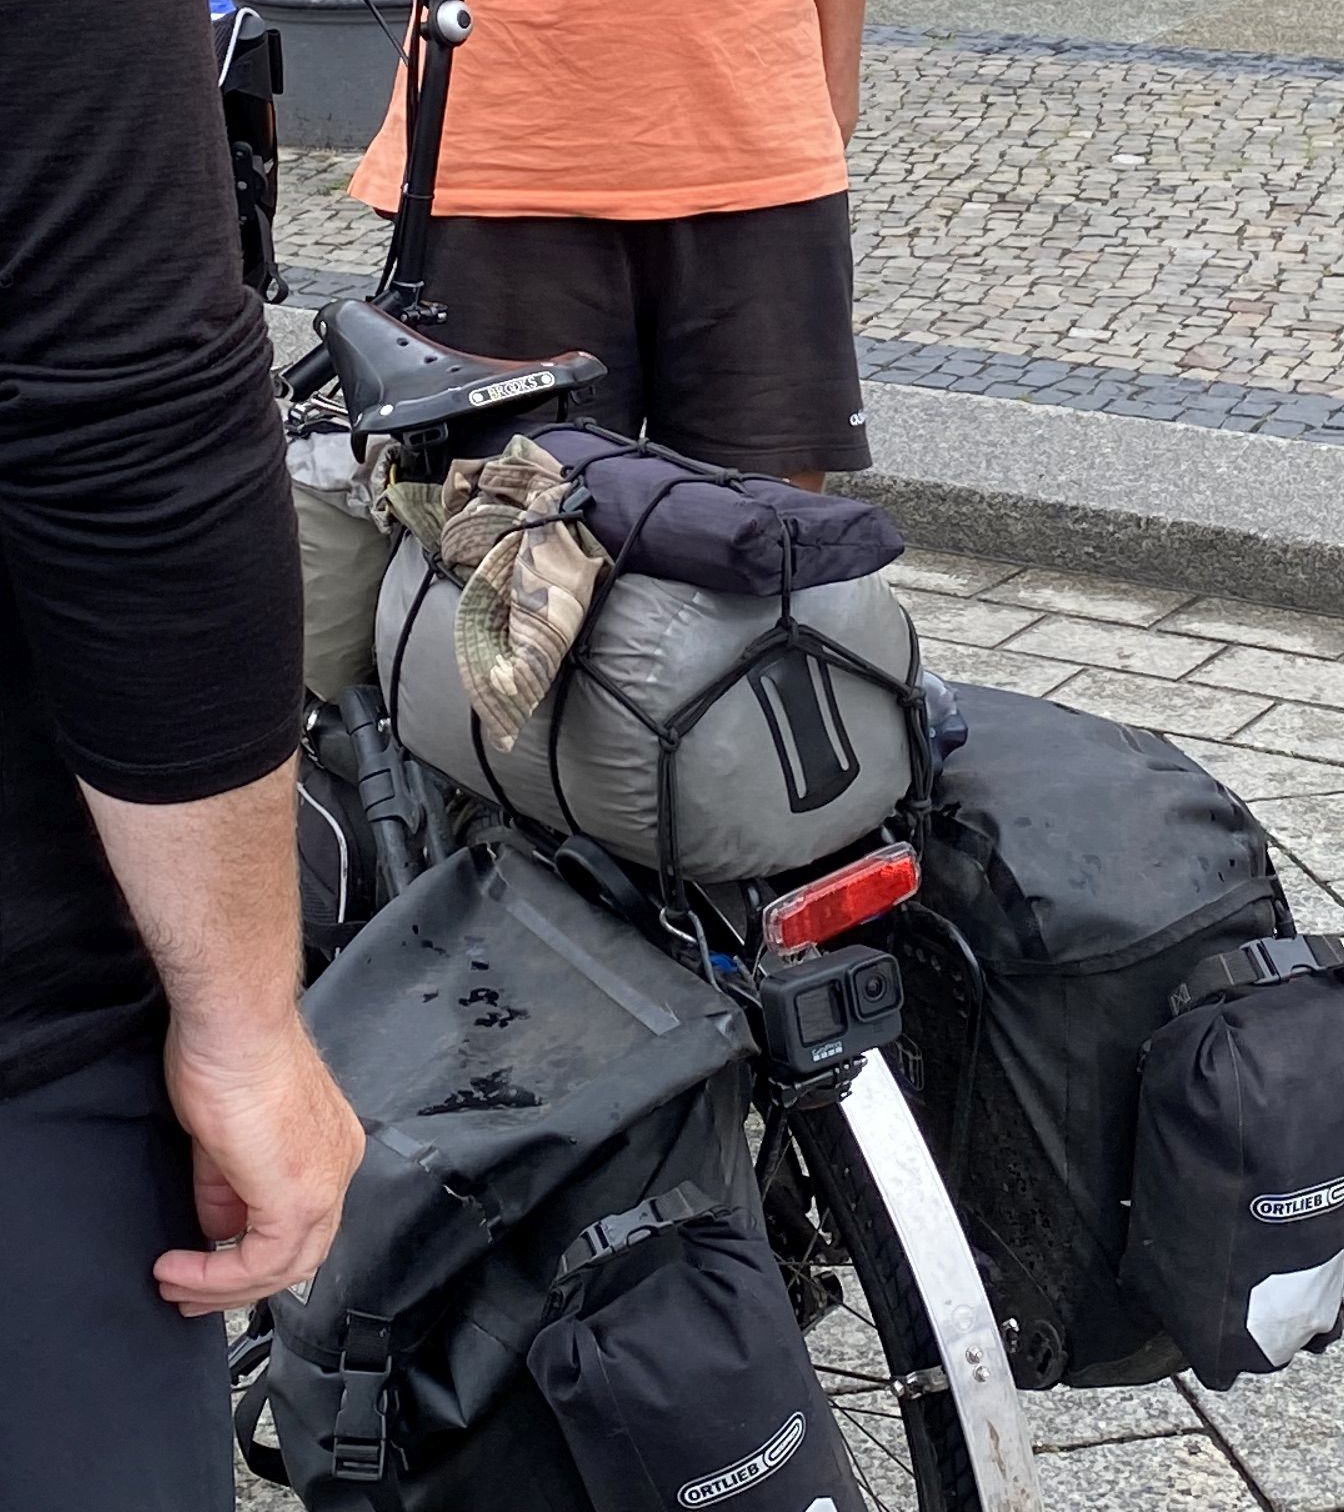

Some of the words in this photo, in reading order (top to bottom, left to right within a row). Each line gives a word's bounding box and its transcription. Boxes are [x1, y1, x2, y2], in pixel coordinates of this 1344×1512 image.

[487, 375, 538, 401] BROOKS
[1259, 1194, 1323, 1216] ORTLIEB
[687, 1462, 760, 1502] ORTLIEB
